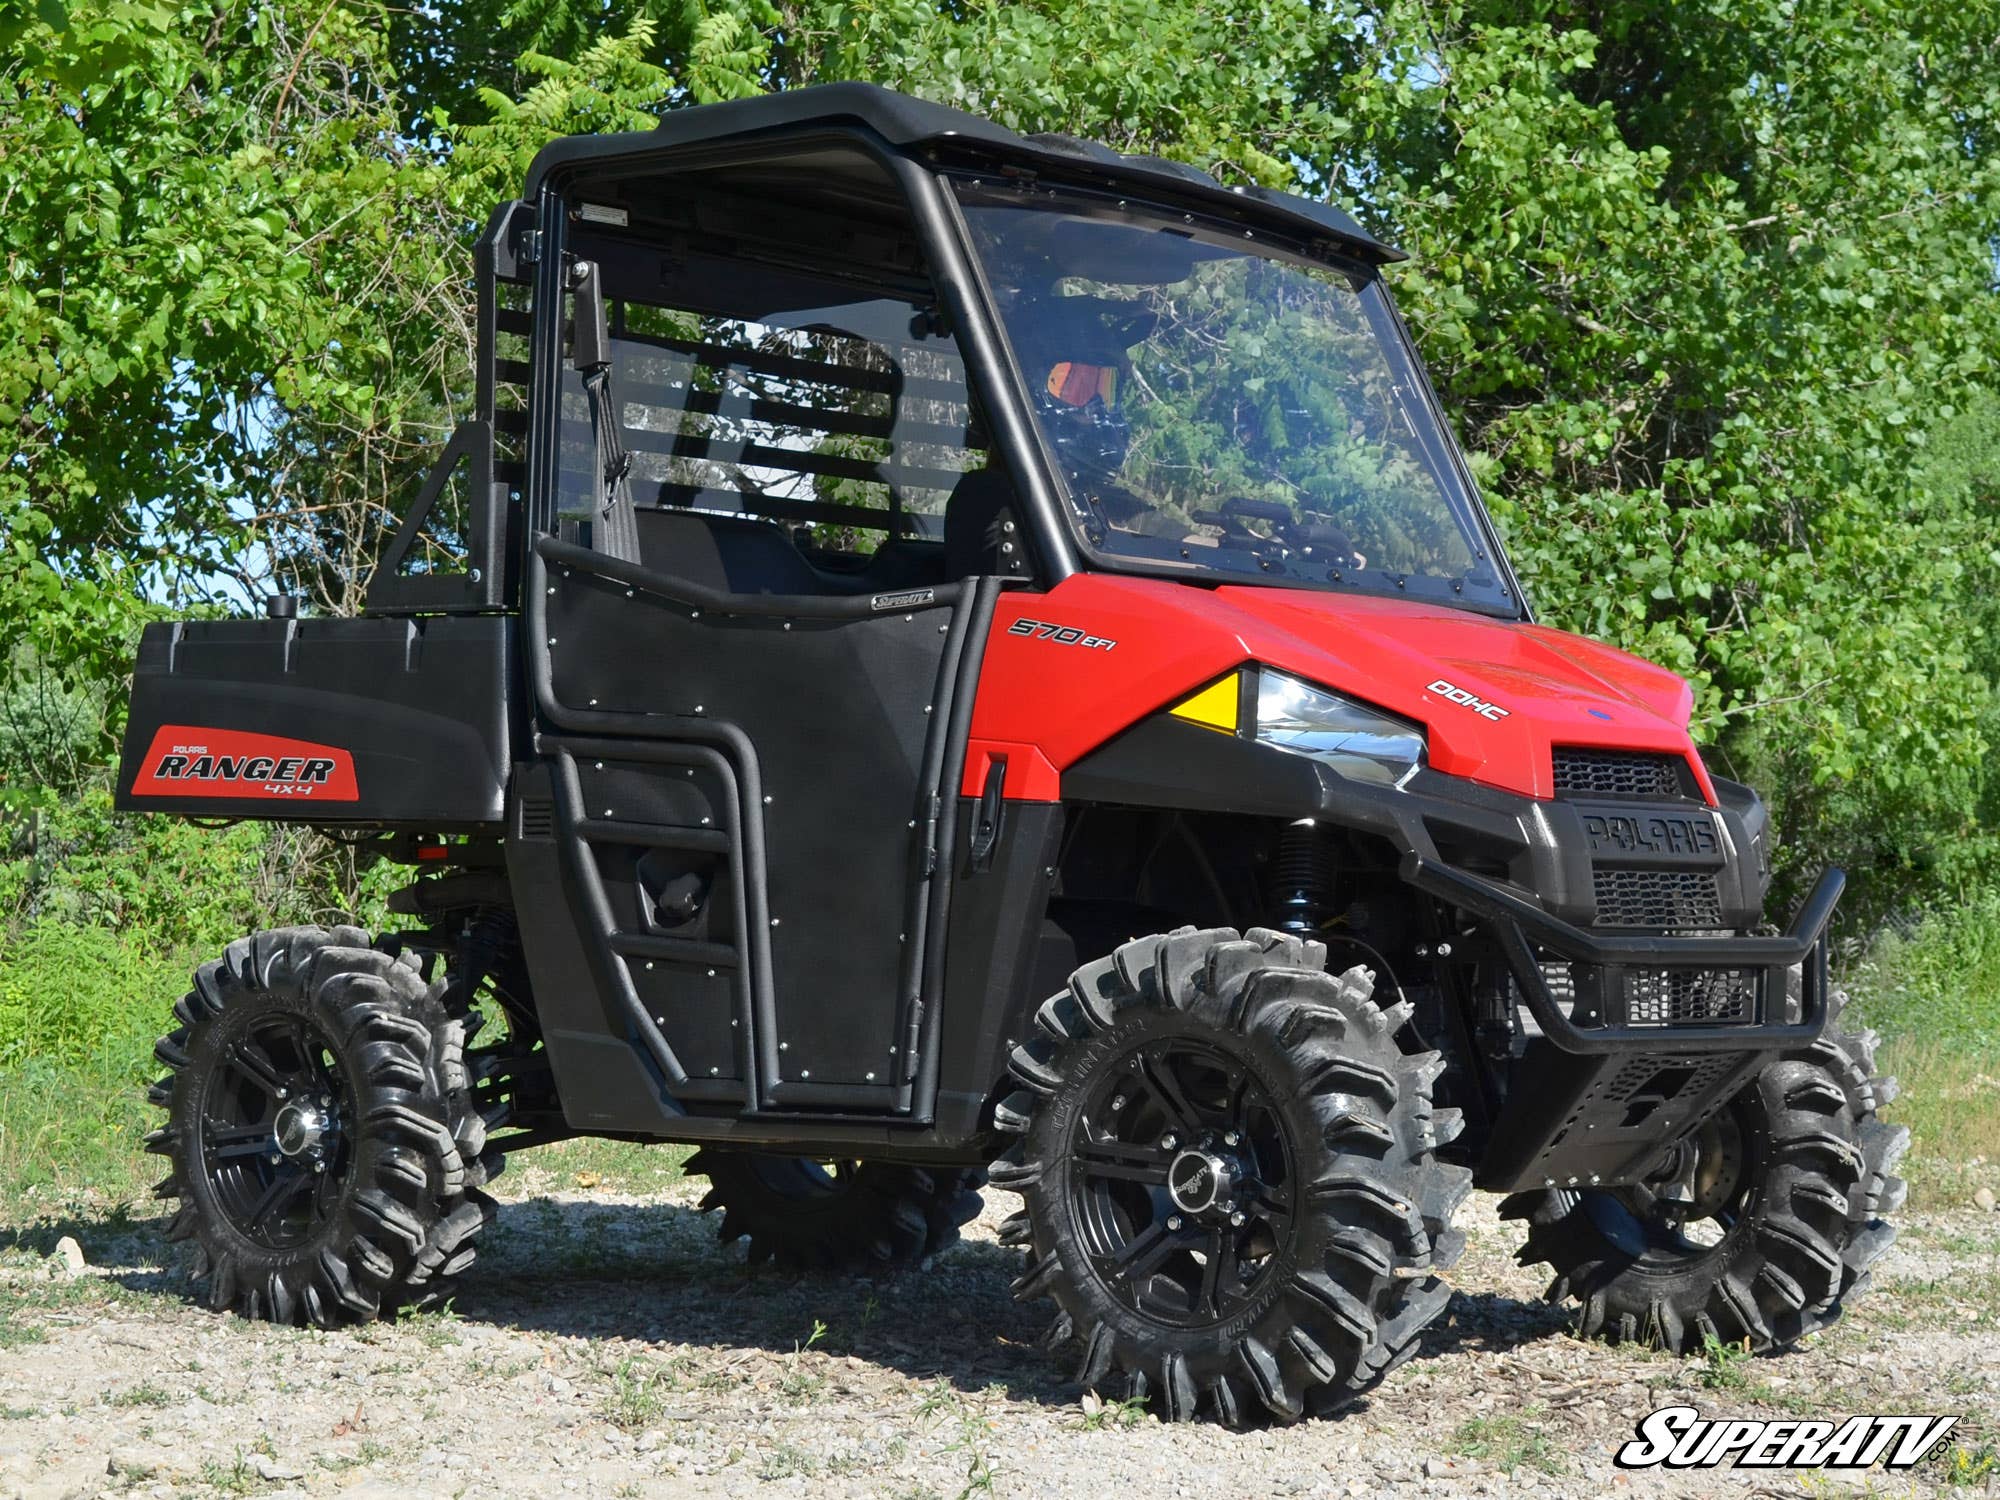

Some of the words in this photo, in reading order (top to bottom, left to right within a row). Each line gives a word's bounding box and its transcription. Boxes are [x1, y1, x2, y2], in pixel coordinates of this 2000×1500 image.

[1008, 617, 1086, 645] 570
[1081, 636, 1117, 651] EFI
[1425, 679, 1512, 721] DOHC
[173, 745, 207, 754] POLARIS
[153, 755, 335, 784] RANGER
[1583, 815, 1717, 854] POLARIS
